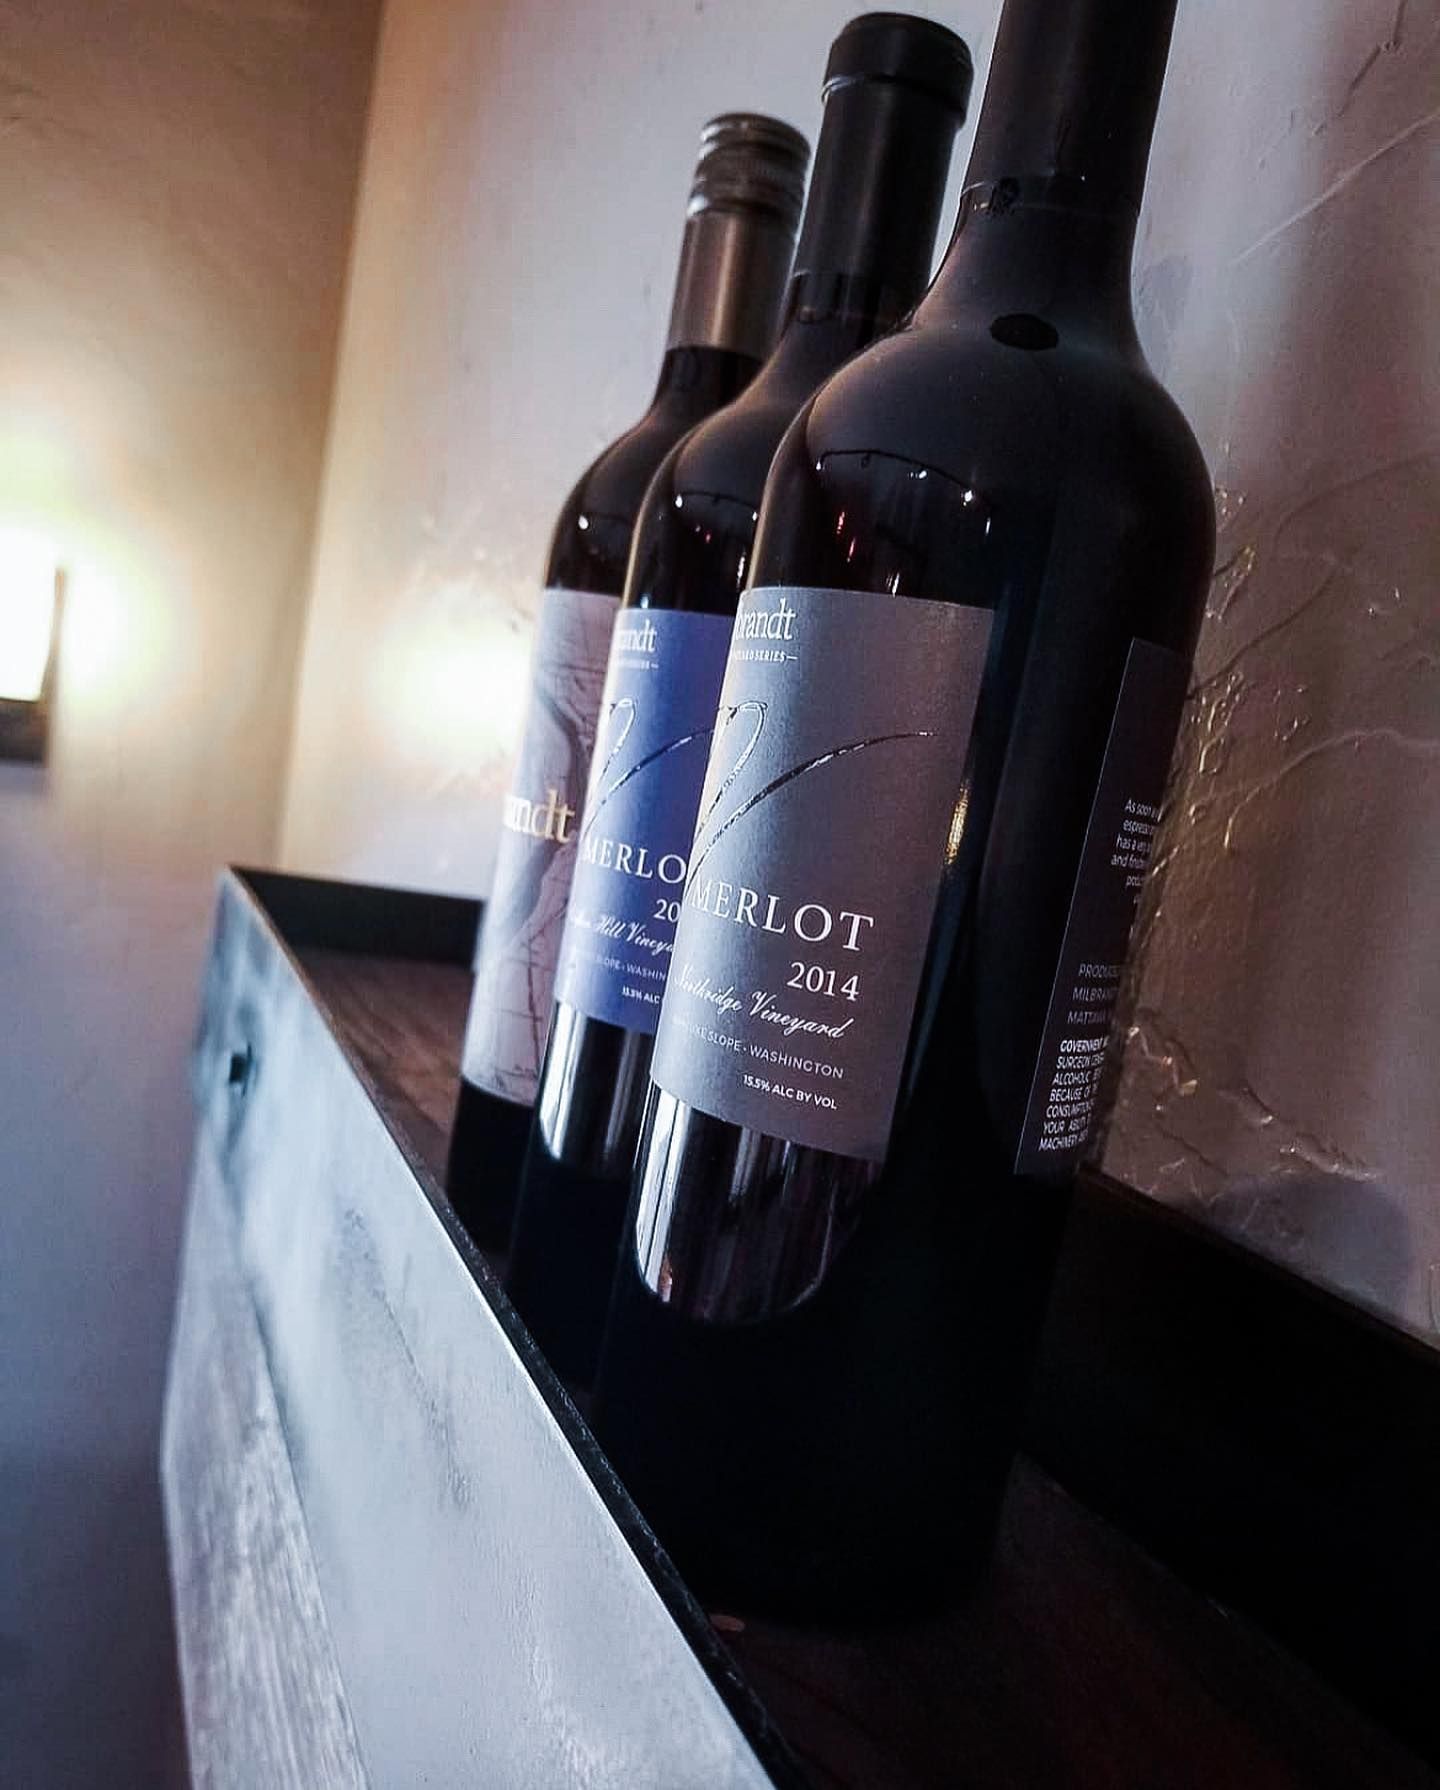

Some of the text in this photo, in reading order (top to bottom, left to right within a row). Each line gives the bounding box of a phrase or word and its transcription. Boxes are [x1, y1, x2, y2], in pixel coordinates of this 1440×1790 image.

[654, 899, 680, 922] 20
[692, 879, 874, 951] MERLOT
[786, 961, 861, 1001] 2014
[750, 991, 855, 1040] Vineyard
[750, 1044, 844, 1079] WASHINGTON
[743, 1074, 837, 1110] 15.5% ALC BY VOL
